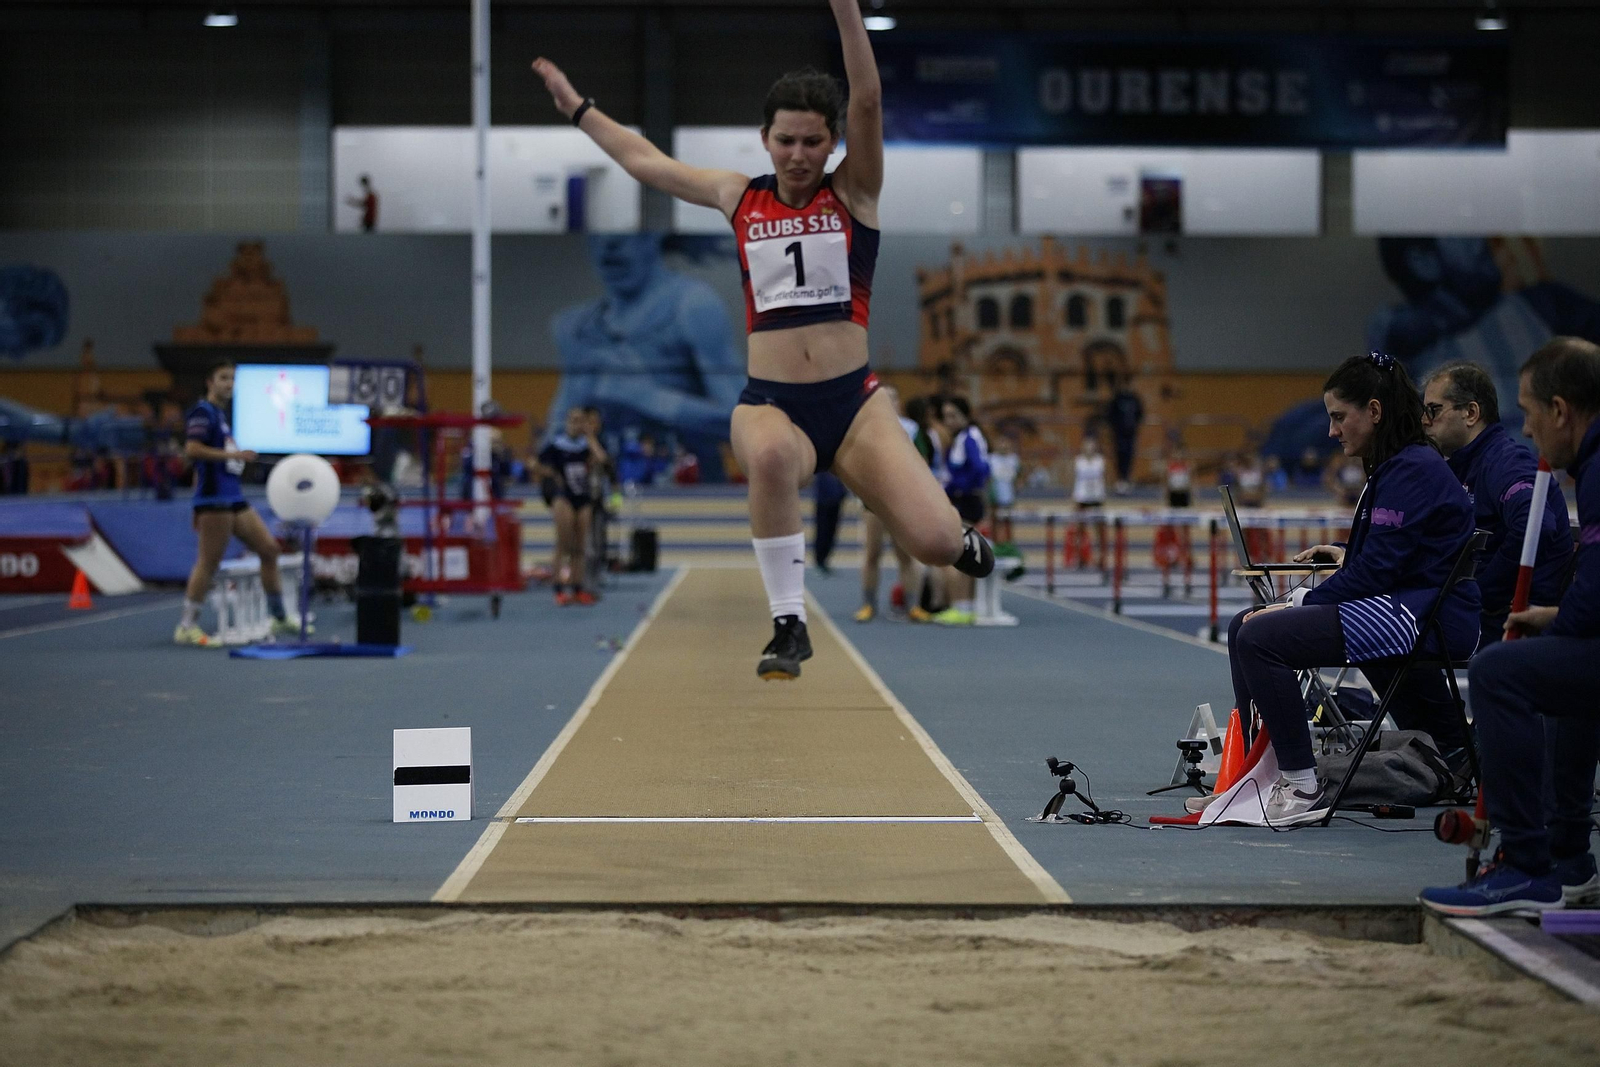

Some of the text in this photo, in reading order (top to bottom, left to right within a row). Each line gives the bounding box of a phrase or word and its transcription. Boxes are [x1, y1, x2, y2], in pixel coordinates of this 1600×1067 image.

[1037, 67, 1310, 115] OURENSE
[748, 213, 842, 240] CLUBS S16
[785, 242, 805, 287] 1
[409, 810, 454, 818] MONDO
